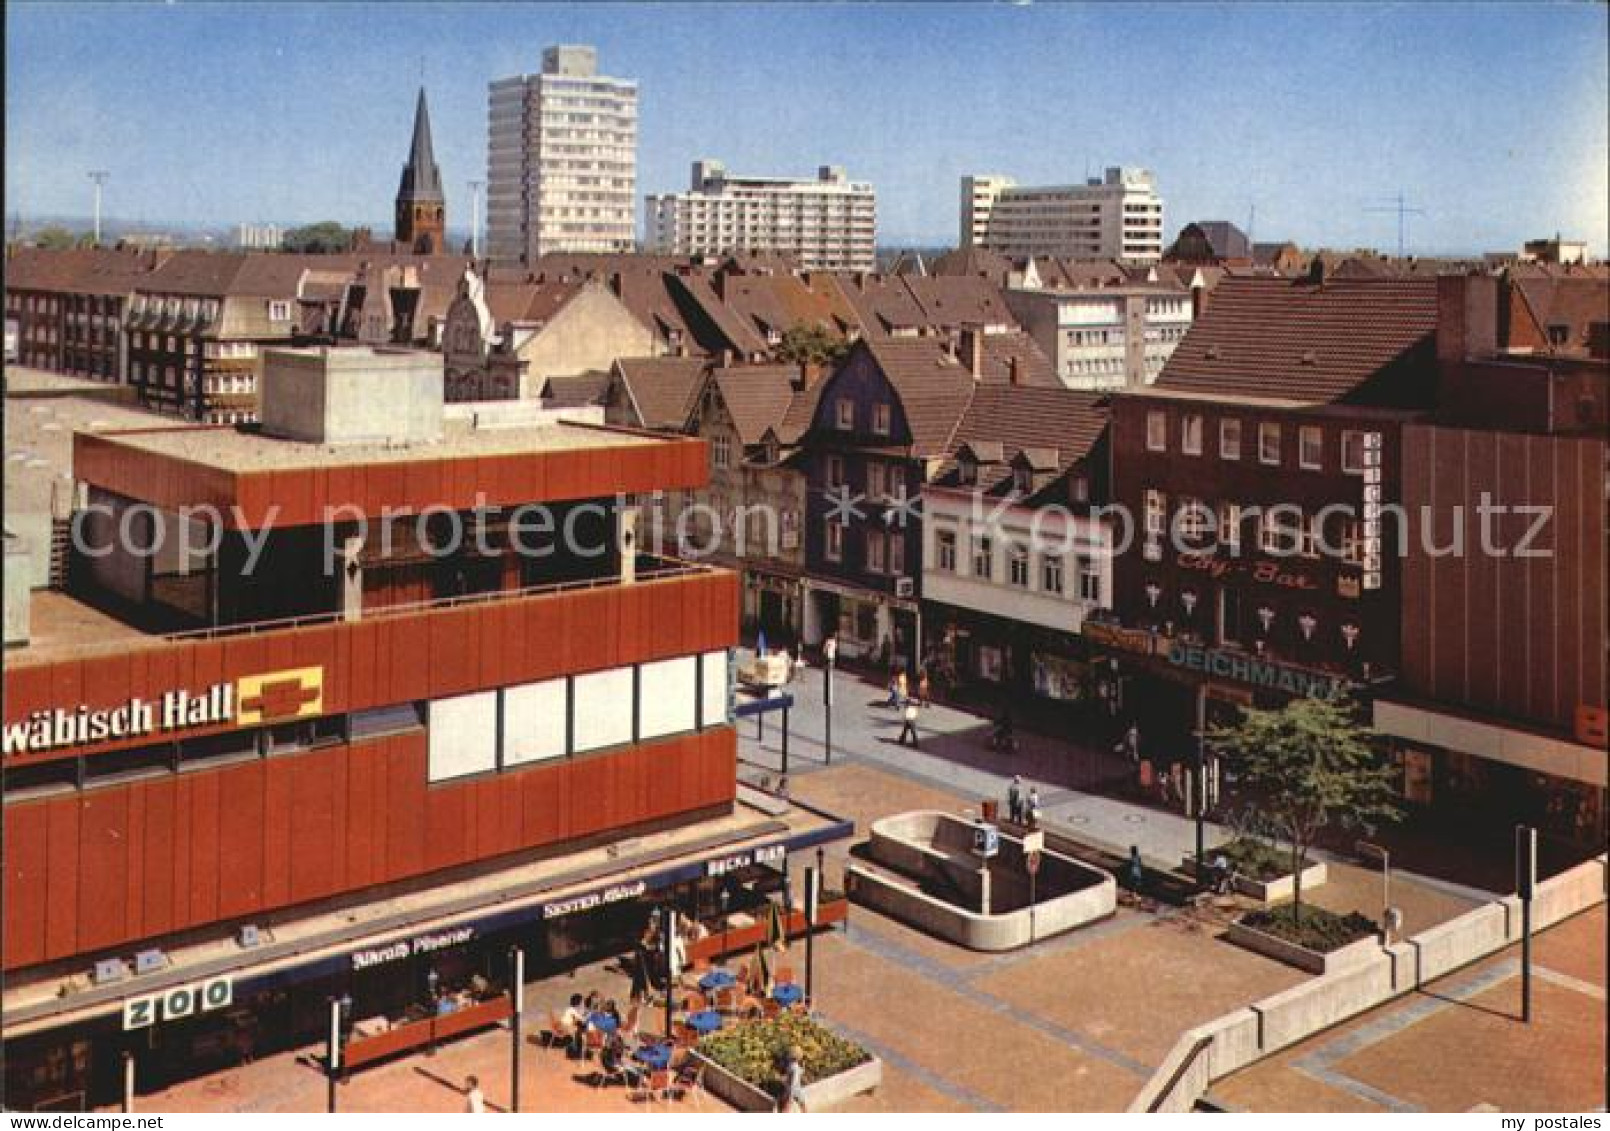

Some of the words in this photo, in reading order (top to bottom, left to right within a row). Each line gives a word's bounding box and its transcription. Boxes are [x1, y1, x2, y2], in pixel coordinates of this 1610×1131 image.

[2, 698, 151, 753] wäbisch
[163, 682, 233, 728] Hall
[129, 977, 230, 1027] ZOO
